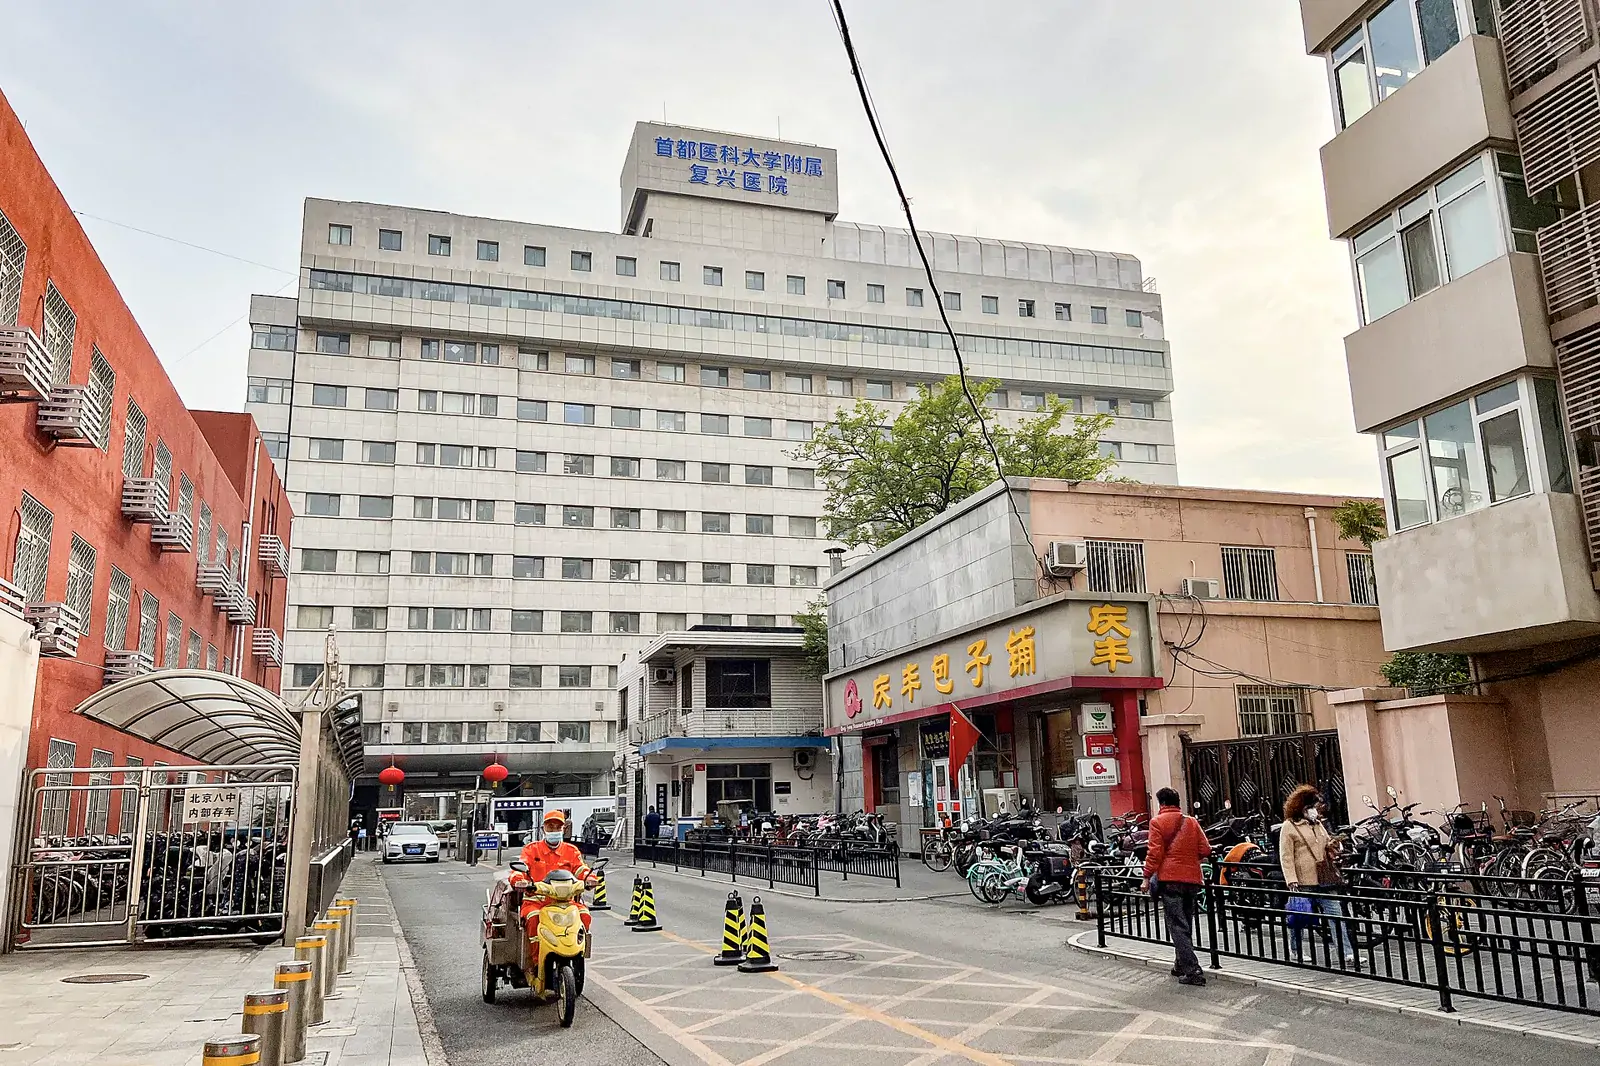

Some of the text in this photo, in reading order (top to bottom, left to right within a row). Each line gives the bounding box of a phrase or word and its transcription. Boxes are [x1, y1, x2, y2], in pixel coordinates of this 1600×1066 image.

[655, 136, 824, 177] 首都医科大学附属
[689, 163, 789, 195] 复兴医院
[1087, 603, 1134, 673] 庆丰
[872, 625, 1036, 710] 庆丰包子铺
[188, 807, 235, 818] 内部存车
[189, 793, 236, 803] 北京八中
